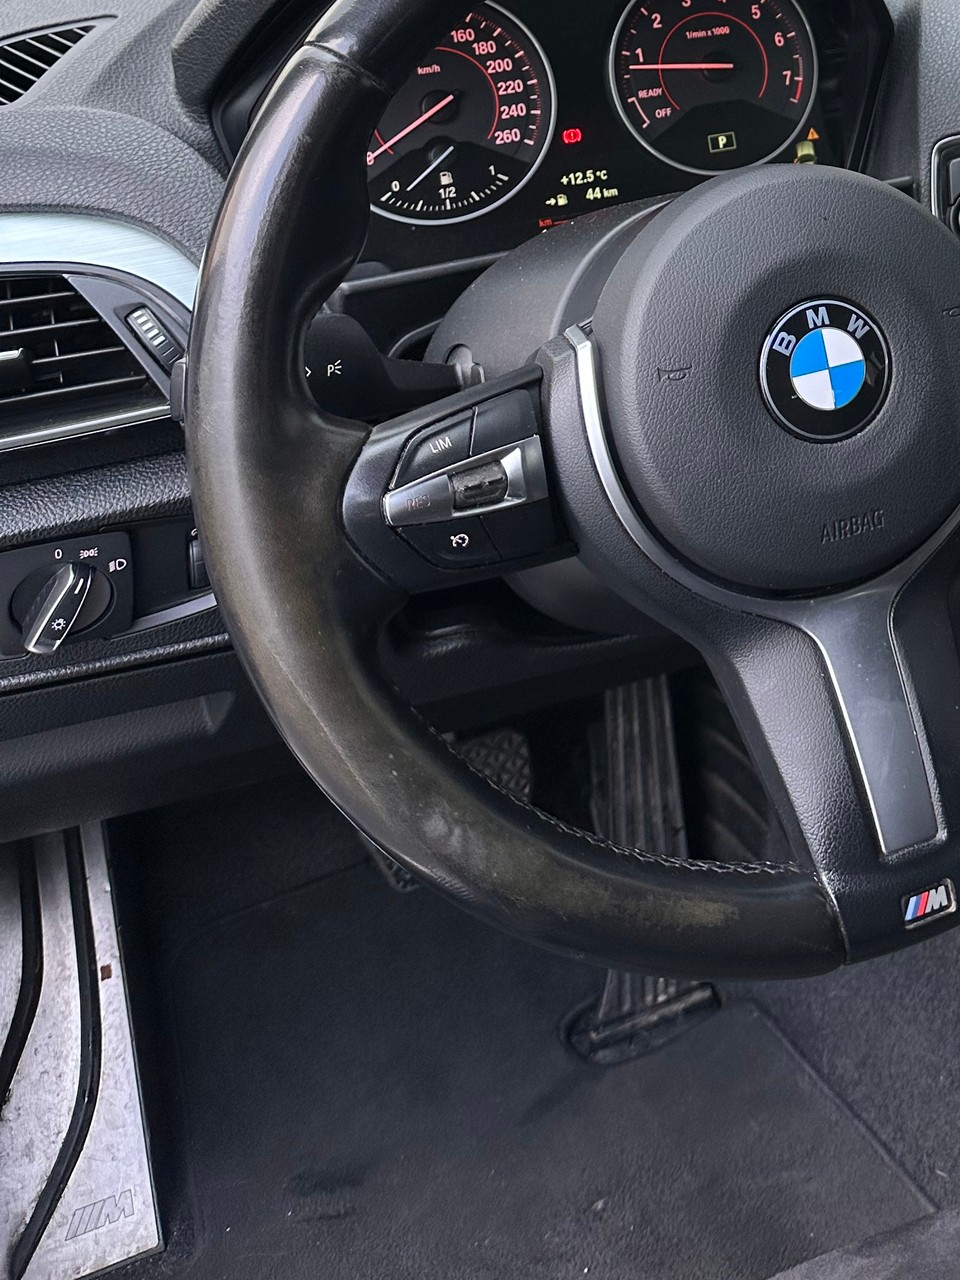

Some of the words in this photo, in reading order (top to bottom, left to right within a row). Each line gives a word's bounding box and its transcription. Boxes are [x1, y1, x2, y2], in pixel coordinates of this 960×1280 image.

[751, 4, 761, 20] 5
[651, 13, 662, 29] 2
[450, 28, 475, 43] 160
[712, 25, 730, 36] 1000
[774, 31, 785, 47] 6
[471, 40, 497, 56] 180
[635, 47, 644, 63] 1
[417, 63, 441, 75] km/h
[486, 57, 513, 74] 200
[782, 70, 792, 86] 7
[497, 79, 524, 95] 220
[638, 87, 663, 99] READY
[500, 103, 527, 119] 240
[655, 107, 672, 119] OFF
[494, 128, 521, 145] 260
[718, 135, 728, 149] P
[488, 165, 495, 176] 1
[391, 180, 400, 192] 0
[438, 187, 457, 199] 1/2
[585, 187, 602, 201] 44
[603, 186, 618, 198] km
[772, 306, 872, 358] BMW
[429, 435, 453, 455] LIM
[406, 494, 431, 511] RES
[819, 508, 887, 546] AIRBAG
[54, 548, 63, 559] 0
